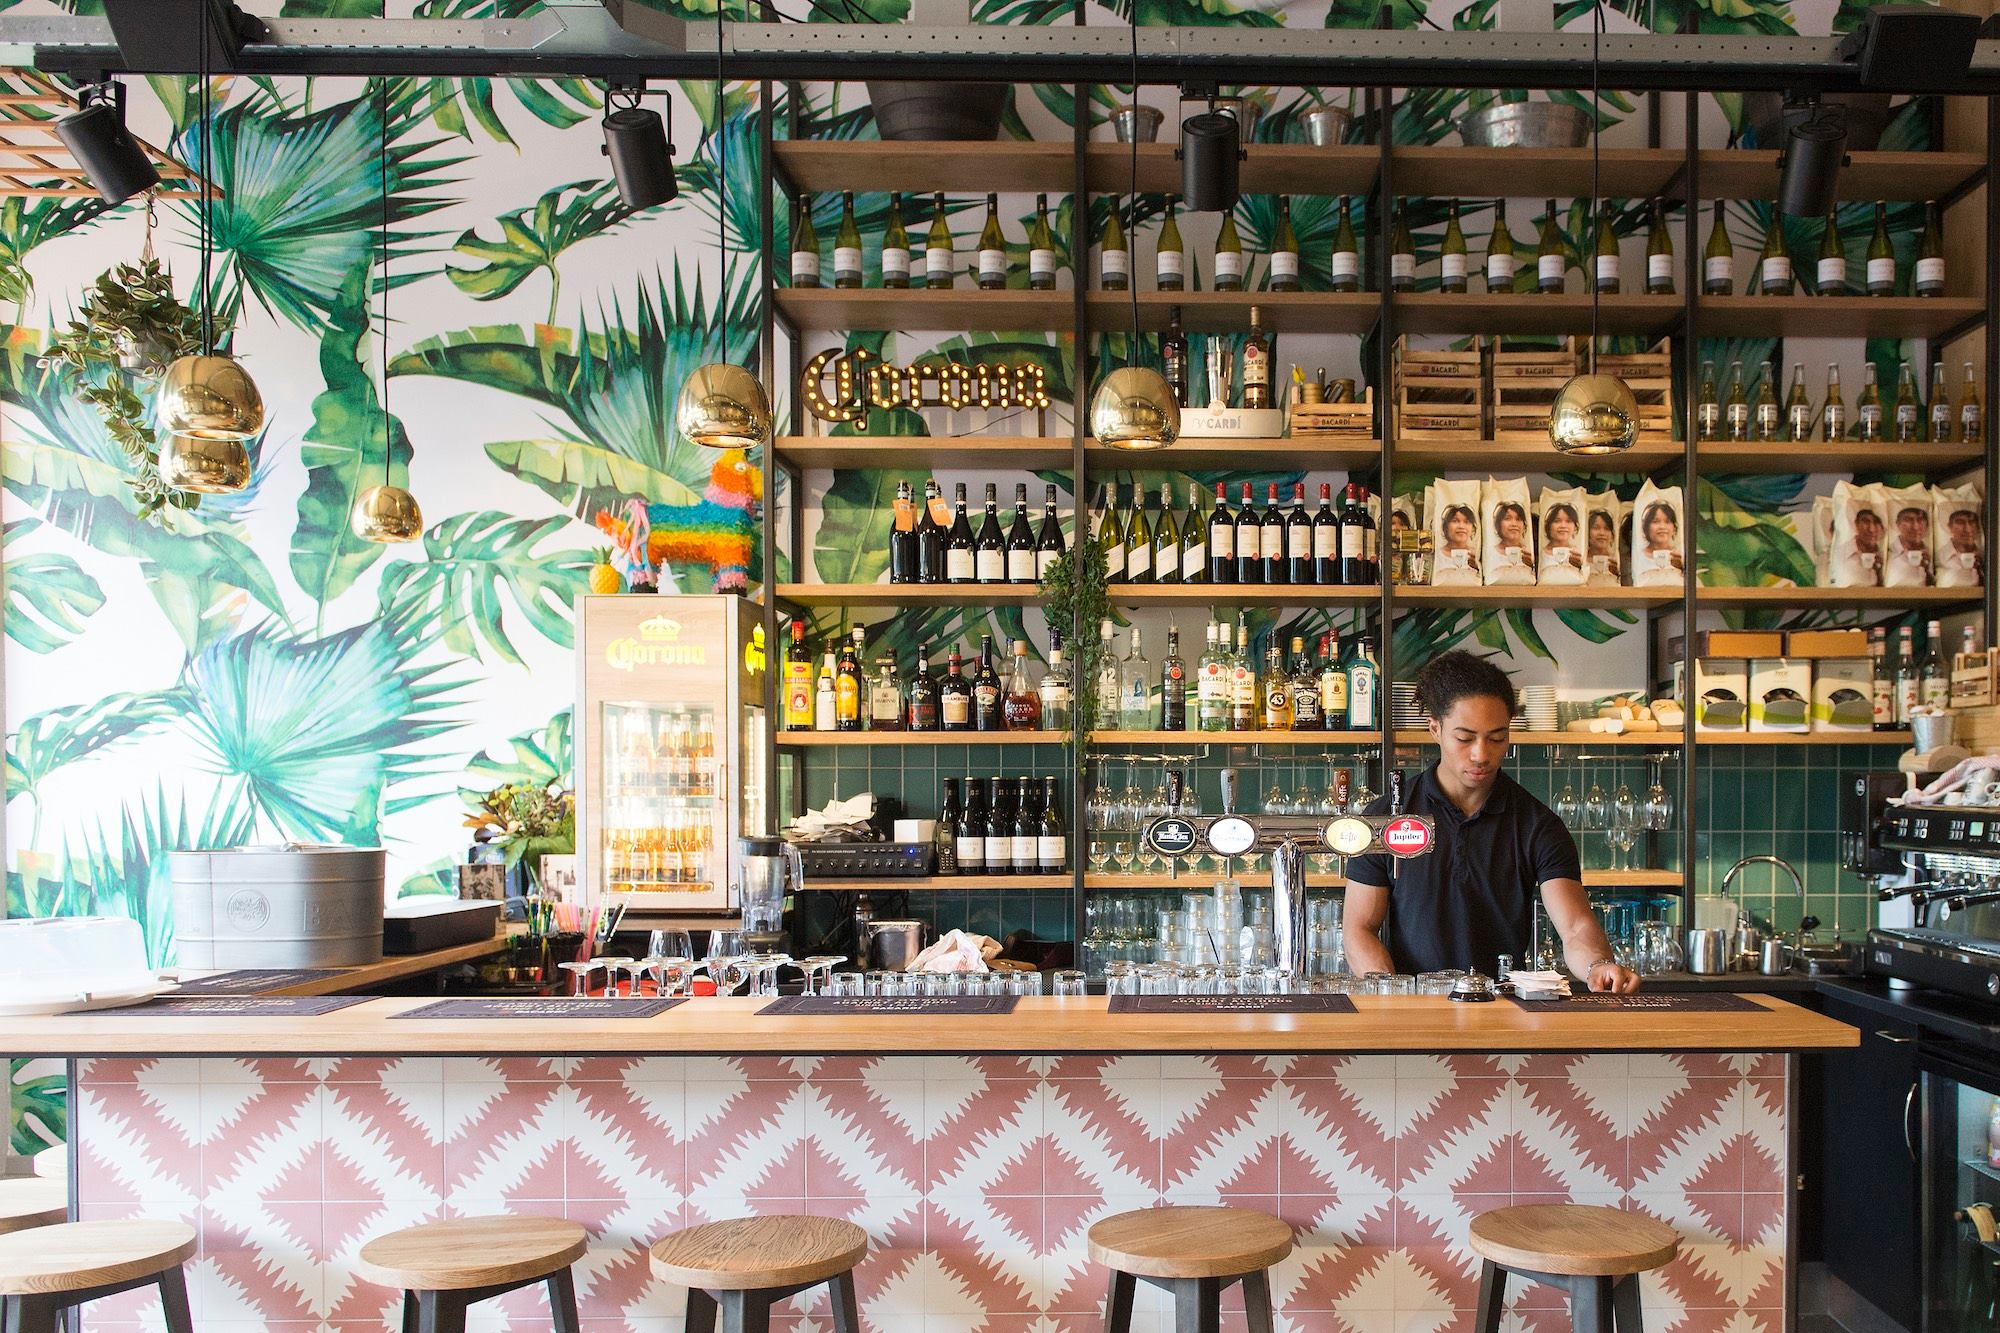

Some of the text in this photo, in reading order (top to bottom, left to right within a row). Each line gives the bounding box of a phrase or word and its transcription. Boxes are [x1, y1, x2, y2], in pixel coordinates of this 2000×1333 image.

[800, 347, 1051, 430] Corona
[605, 636, 706, 673] Corona
[1099, 667, 1116, 683] 42
[1271, 694, 1285, 704] 43
[1393, 833, 1421, 842] Jupiler
